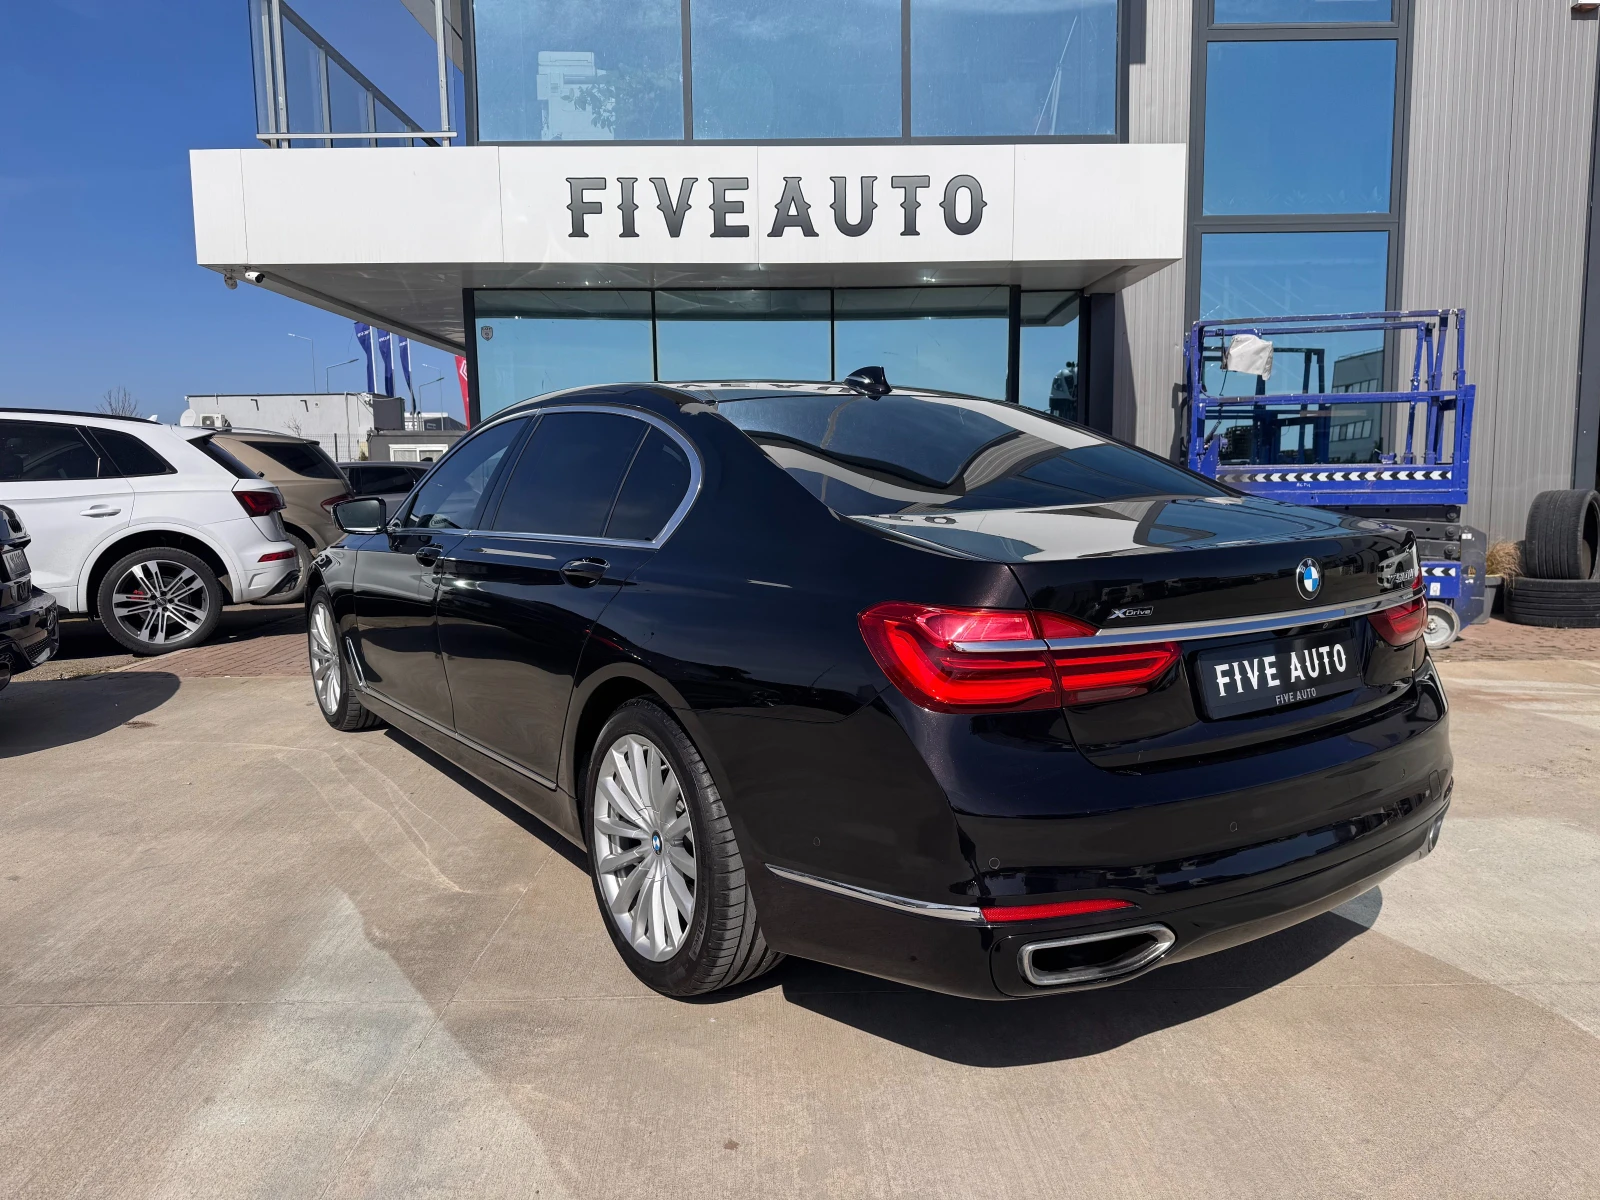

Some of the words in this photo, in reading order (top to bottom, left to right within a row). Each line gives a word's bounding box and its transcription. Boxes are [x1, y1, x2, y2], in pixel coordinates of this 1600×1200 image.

[566, 177, 750, 238] FIVE
[767, 174, 988, 238] AUTO
[1214, 655, 1281, 697] FIVE
[1290, 643, 1347, 683] AUTO
[1275, 692, 1295, 706] FIVE
[1296, 687, 1317, 701] AUTO
